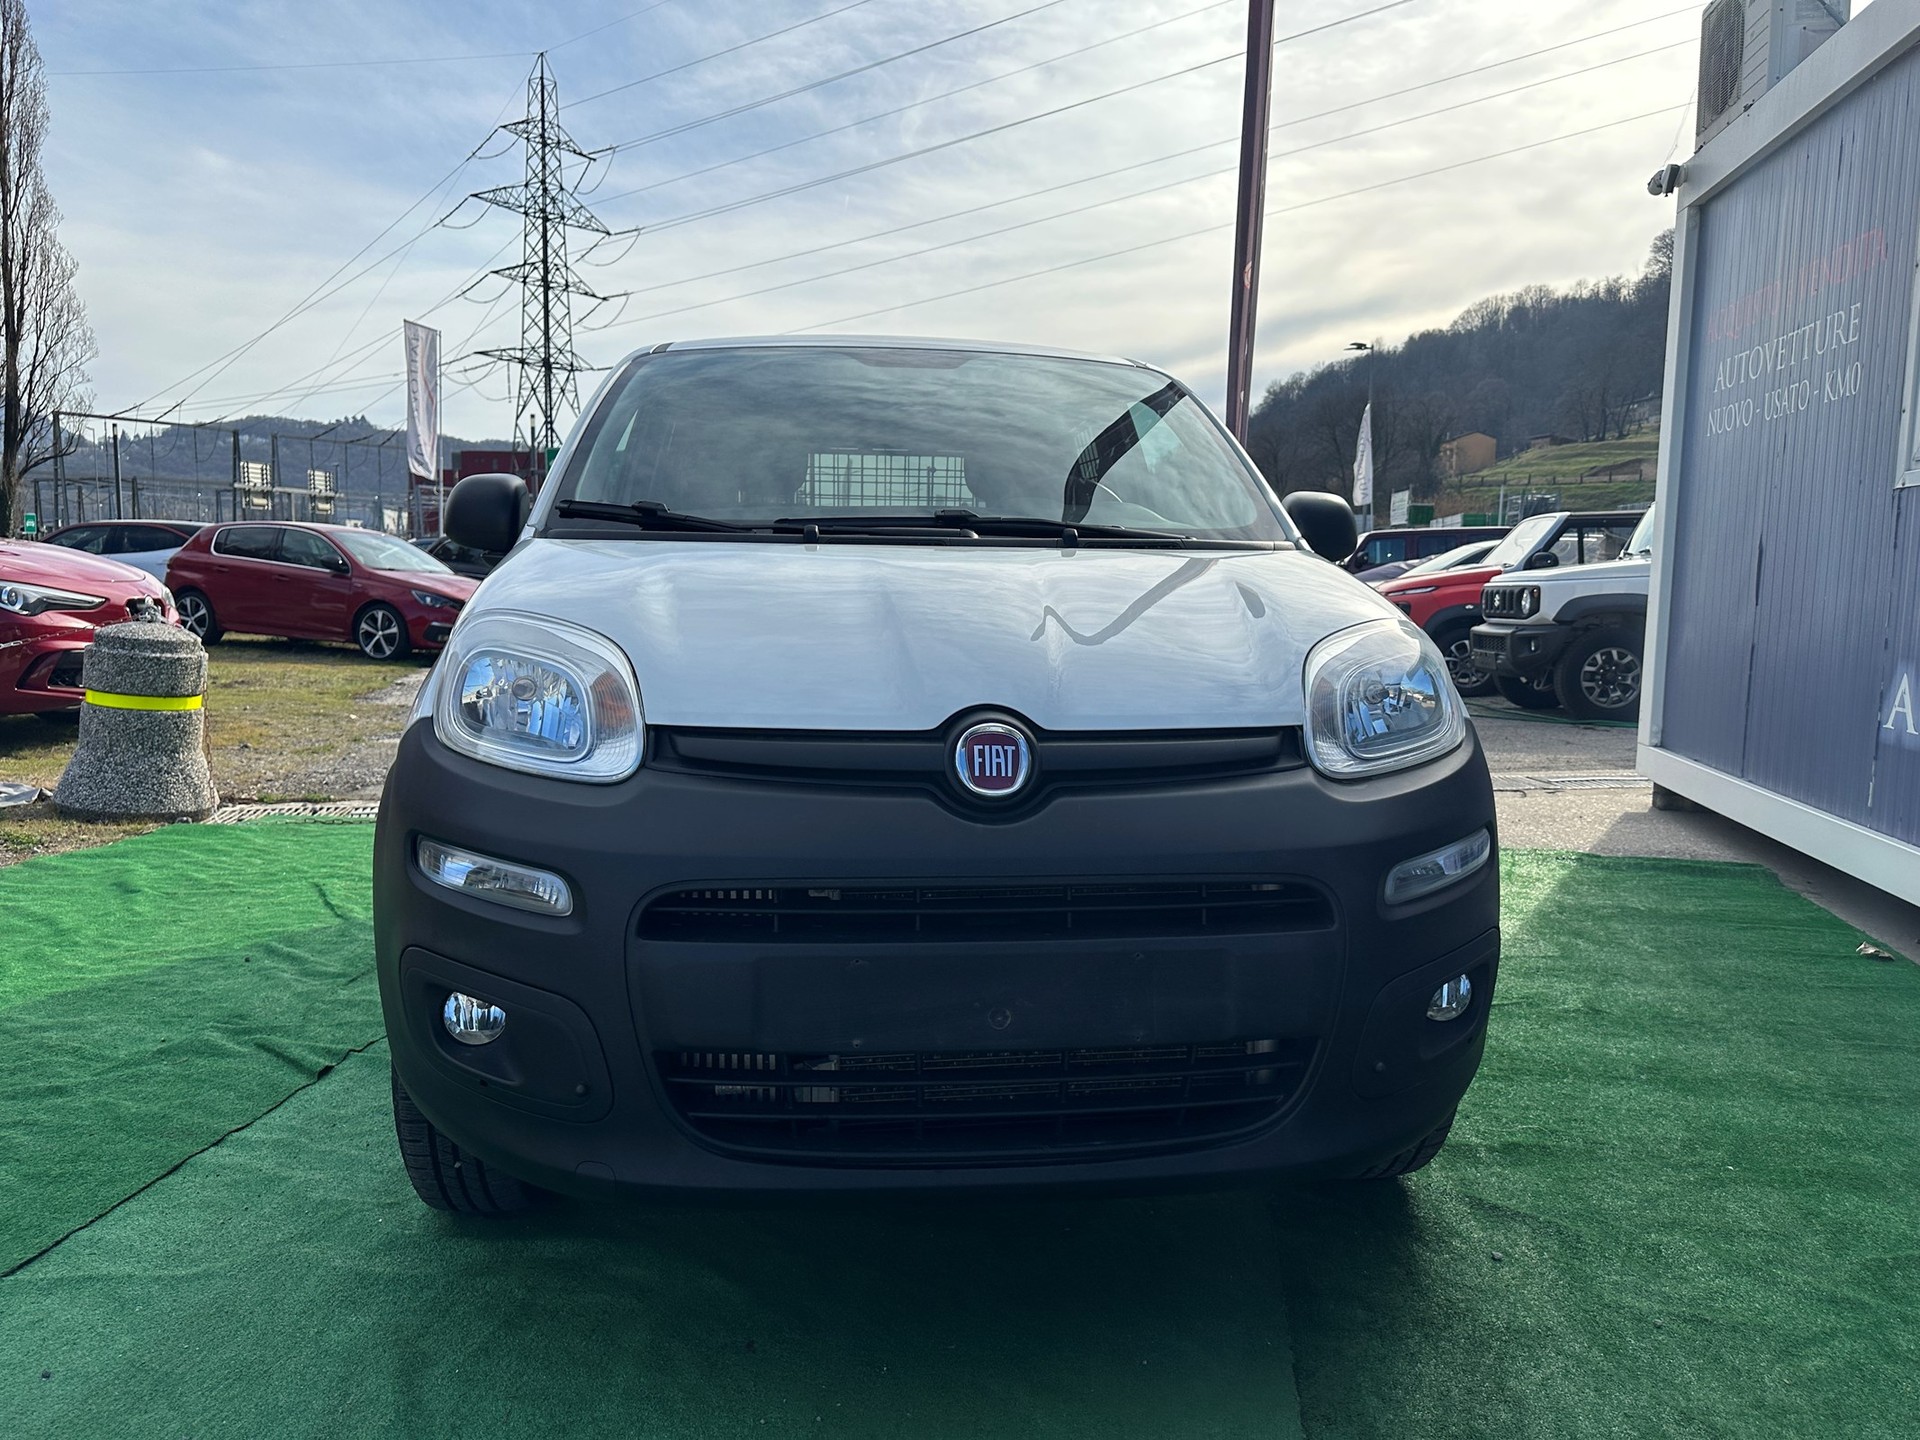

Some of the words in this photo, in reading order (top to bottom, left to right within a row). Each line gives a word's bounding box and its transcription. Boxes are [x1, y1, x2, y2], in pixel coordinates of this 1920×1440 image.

[1713, 302, 1861, 393] AUTOVETTURE
[1706, 398, 1753, 437] NUOVO
[1764, 379, 1810, 421] USATO
[1882, 672, 1919, 735] A
[973, 744, 1016, 777] FIAT
